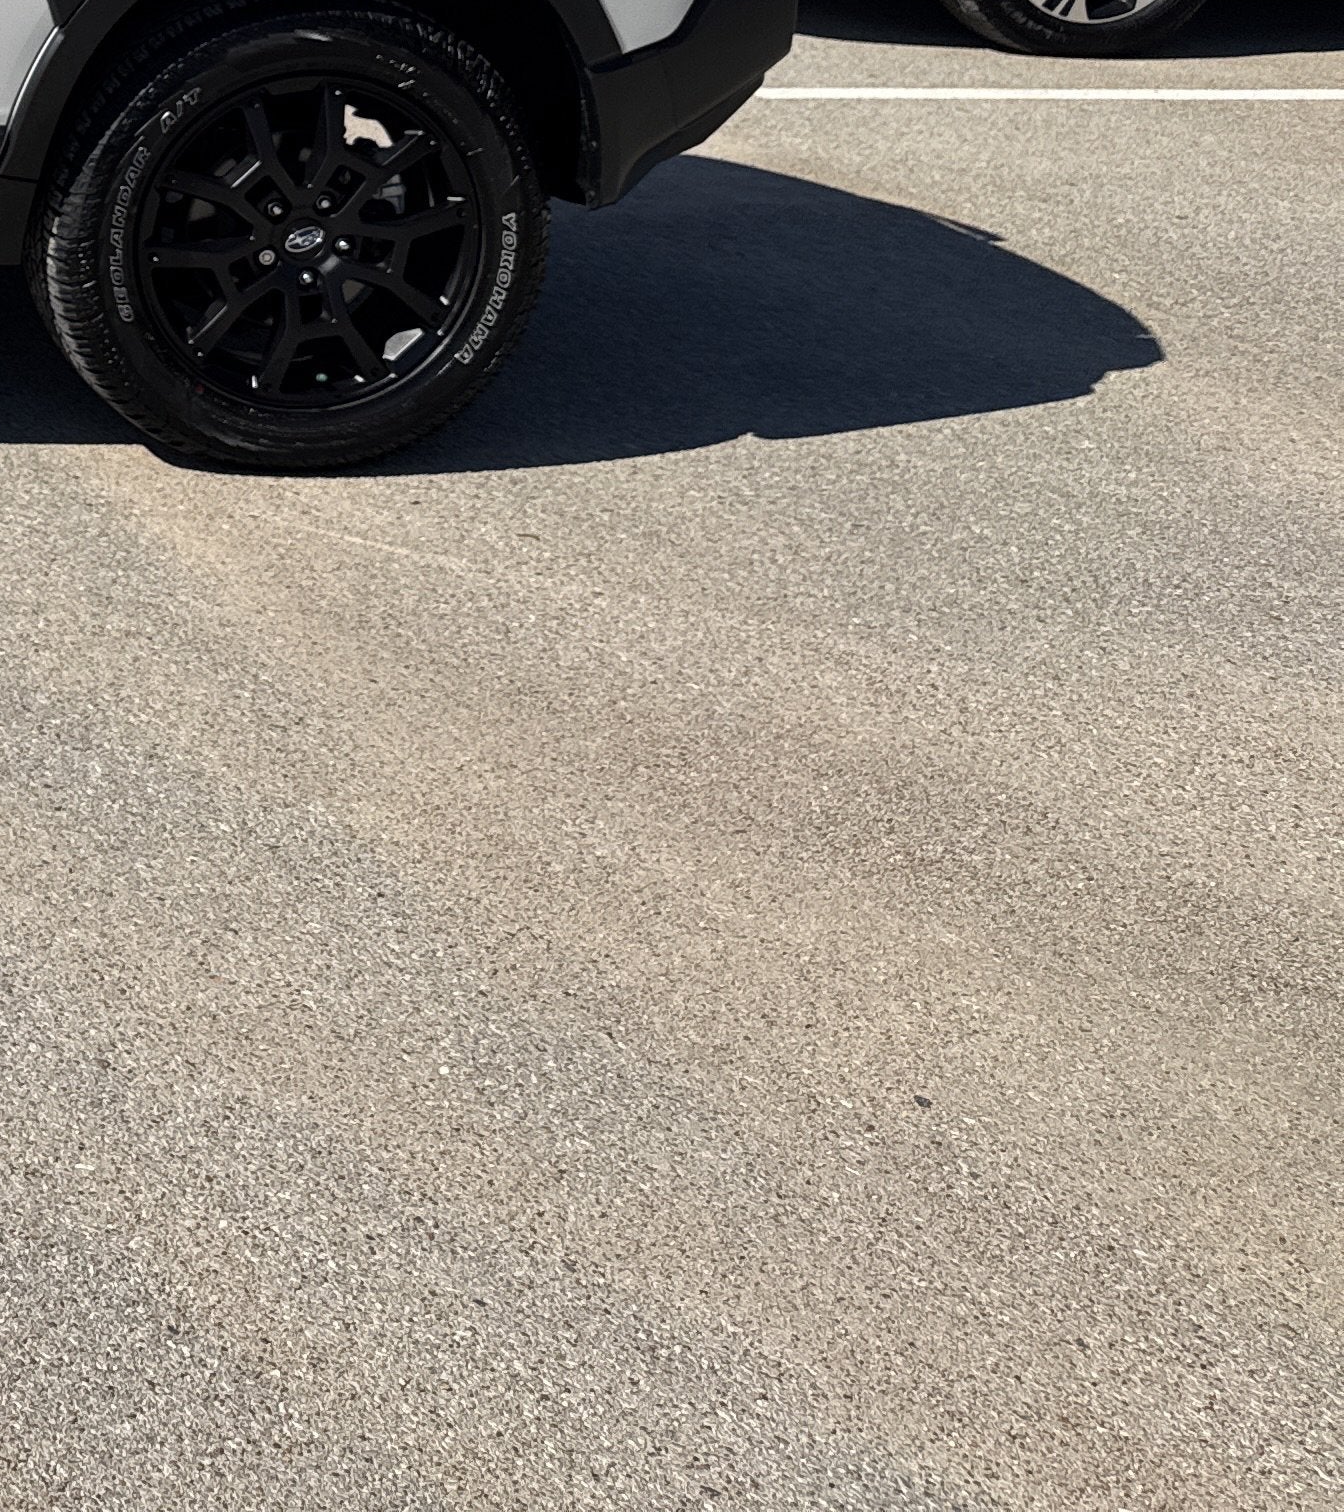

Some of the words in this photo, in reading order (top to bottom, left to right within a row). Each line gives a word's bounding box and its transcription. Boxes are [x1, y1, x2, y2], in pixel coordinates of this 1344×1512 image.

[109, 146, 152, 323] GEOLANDAR
[159, 86, 202, 134] A/T
[456, 211, 518, 365] YOKOHAMA
